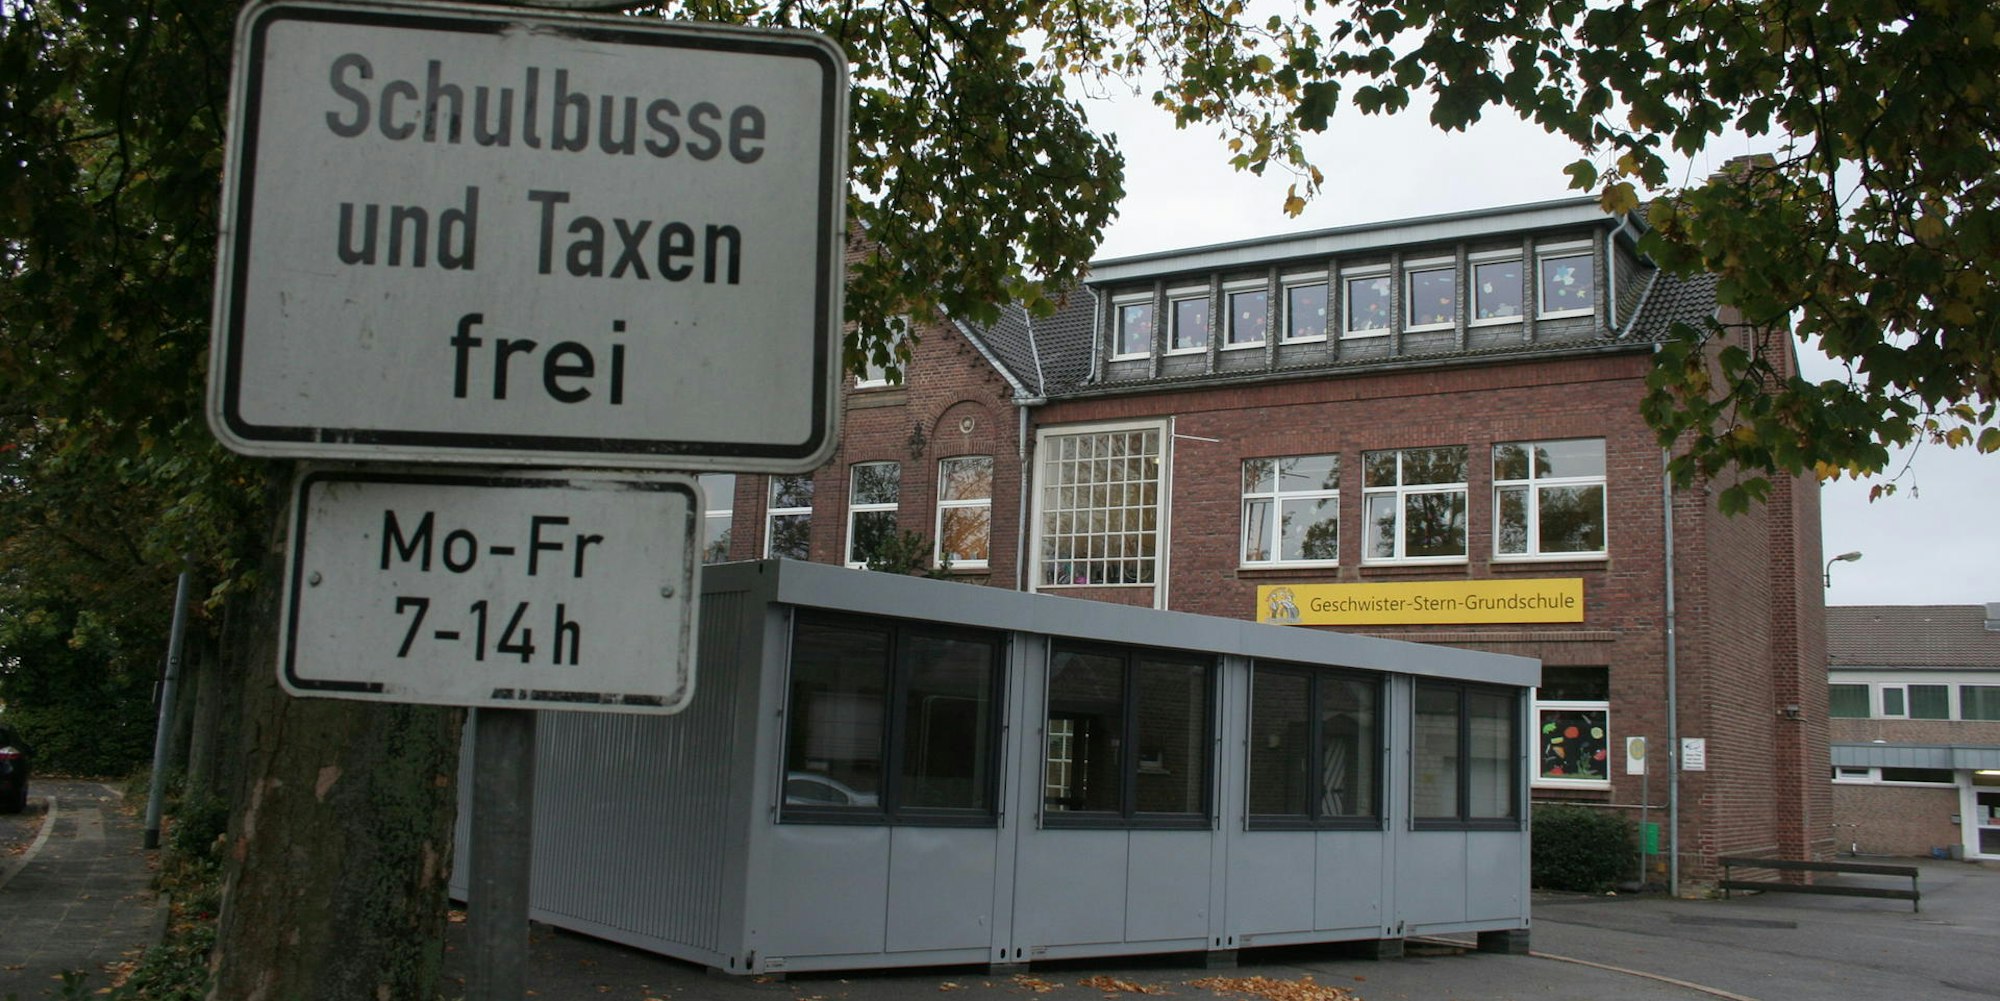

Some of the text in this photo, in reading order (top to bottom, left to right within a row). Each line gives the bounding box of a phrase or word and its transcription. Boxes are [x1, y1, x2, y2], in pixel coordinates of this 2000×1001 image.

[325, 52, 766, 165] Schulbusse
[337, 185, 742, 286] und Taxen
[450, 312, 626, 405] frei
[380, 509, 604, 579] Mo-Fr
[1310, 592, 1575, 613] Geschwister-Stern-Grundschule
